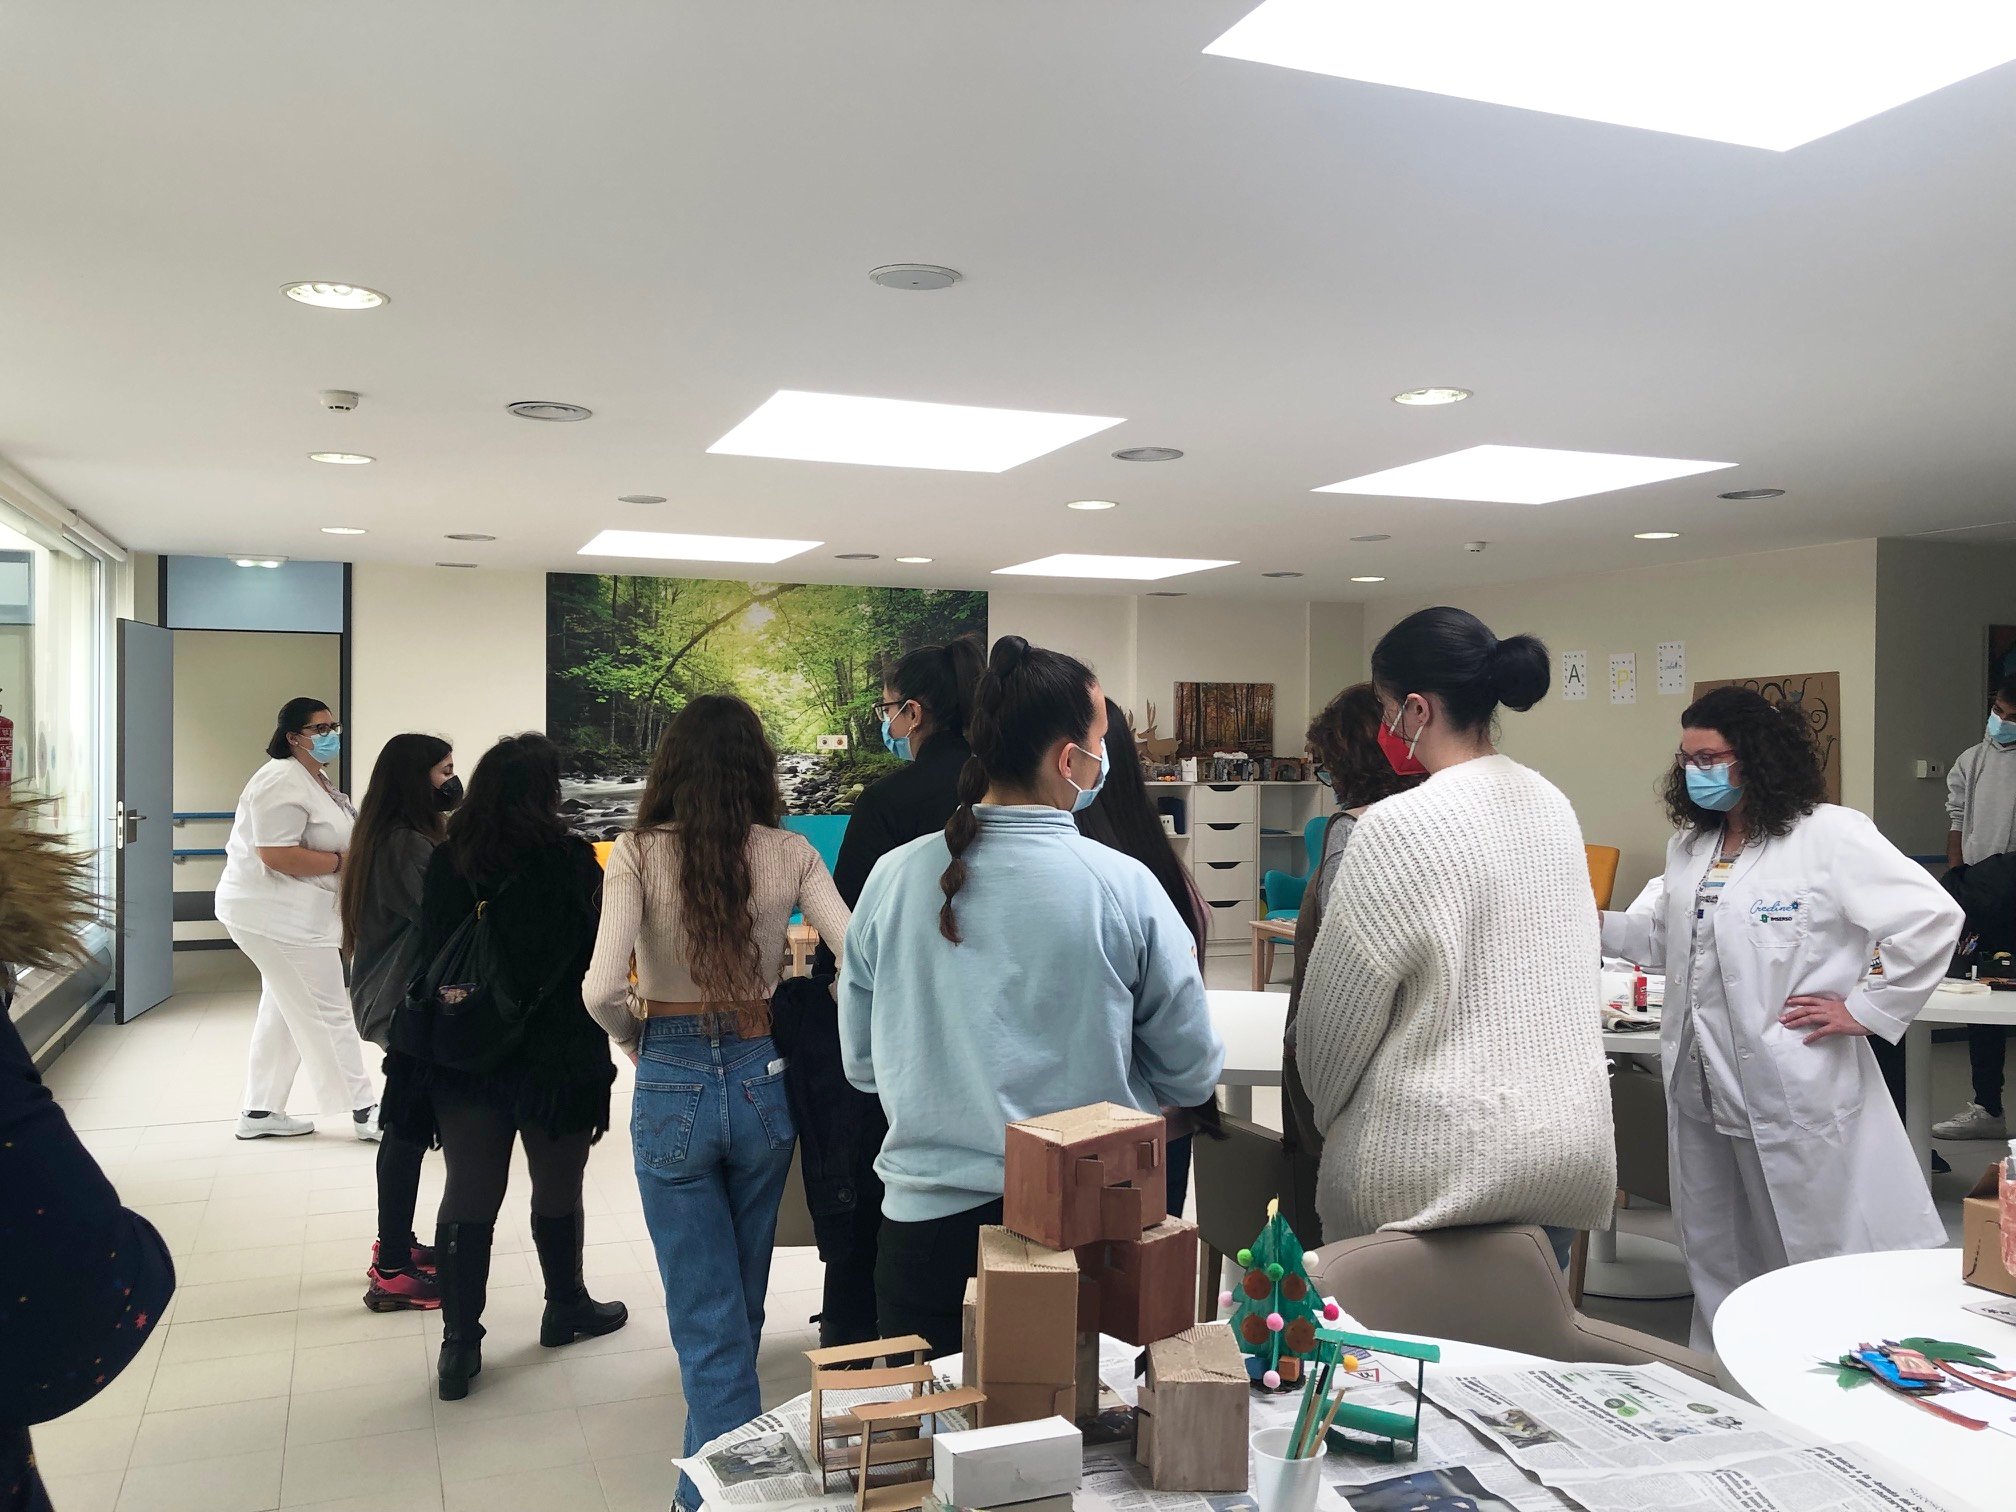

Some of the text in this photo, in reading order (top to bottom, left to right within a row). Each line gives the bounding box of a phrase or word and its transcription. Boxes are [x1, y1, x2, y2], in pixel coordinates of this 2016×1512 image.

[1568, 663, 1581, 684] A
[1616, 668, 1630, 689] P
[1750, 899, 1792, 914] Credine
